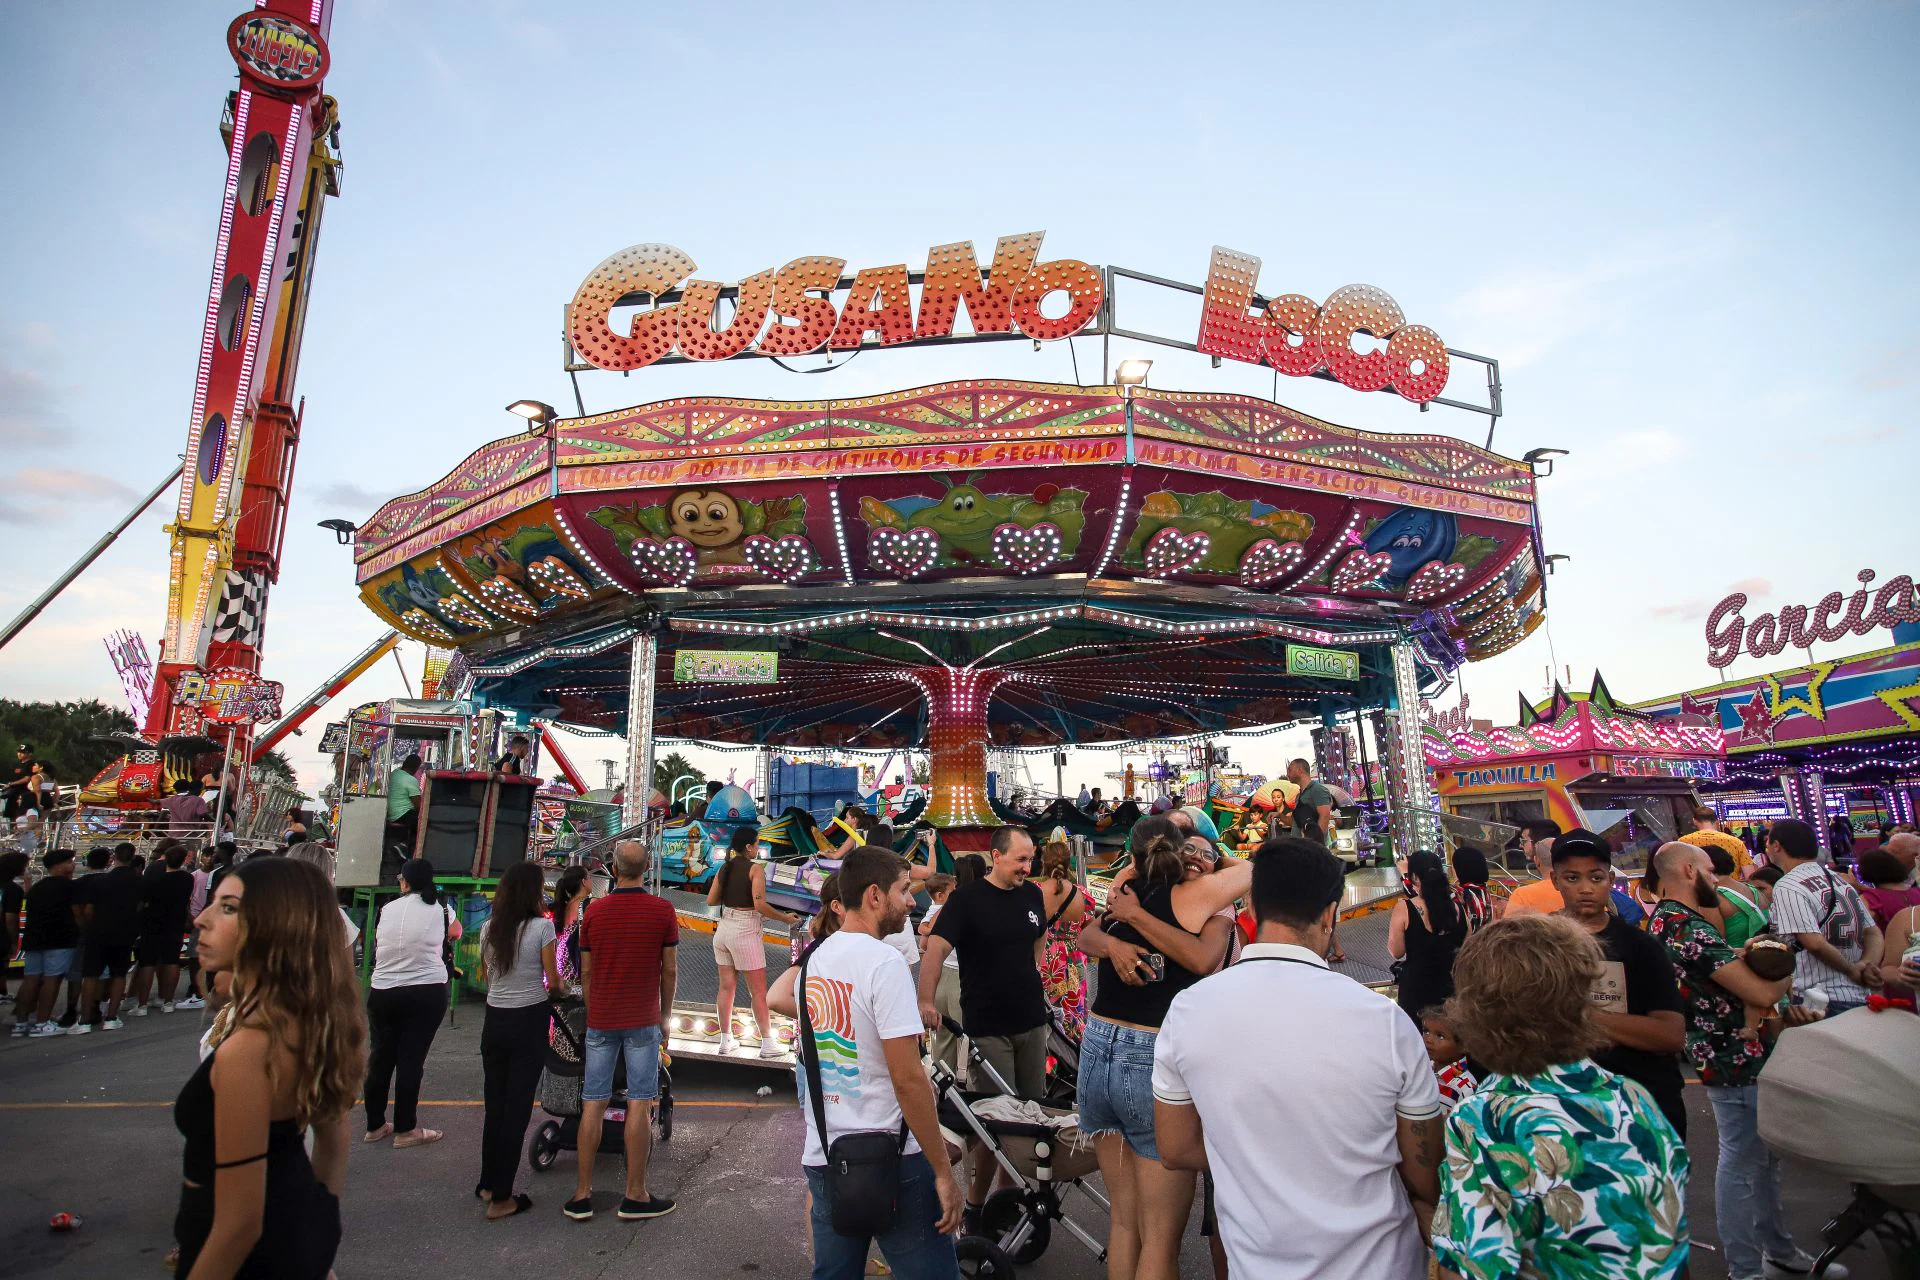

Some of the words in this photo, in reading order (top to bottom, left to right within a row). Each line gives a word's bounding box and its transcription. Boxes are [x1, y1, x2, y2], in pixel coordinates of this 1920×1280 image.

[688, 459, 765, 478] DOTADA
[777, 456, 800, 471] DE
[811, 450, 946, 471] CINTURONES
[957, 449, 983, 463] DE
[998, 441, 1118, 460] SEGURIDAD
[1139, 444, 1238, 472] MAXIMA
[1260, 462, 1378, 495] SENSACION
[1397, 486, 1470, 510] GUSANO
[1486, 501, 1527, 520] LOCO
[1295, 651, 1343, 674] Salida
[1453, 764, 1556, 787] TAQUILLA
